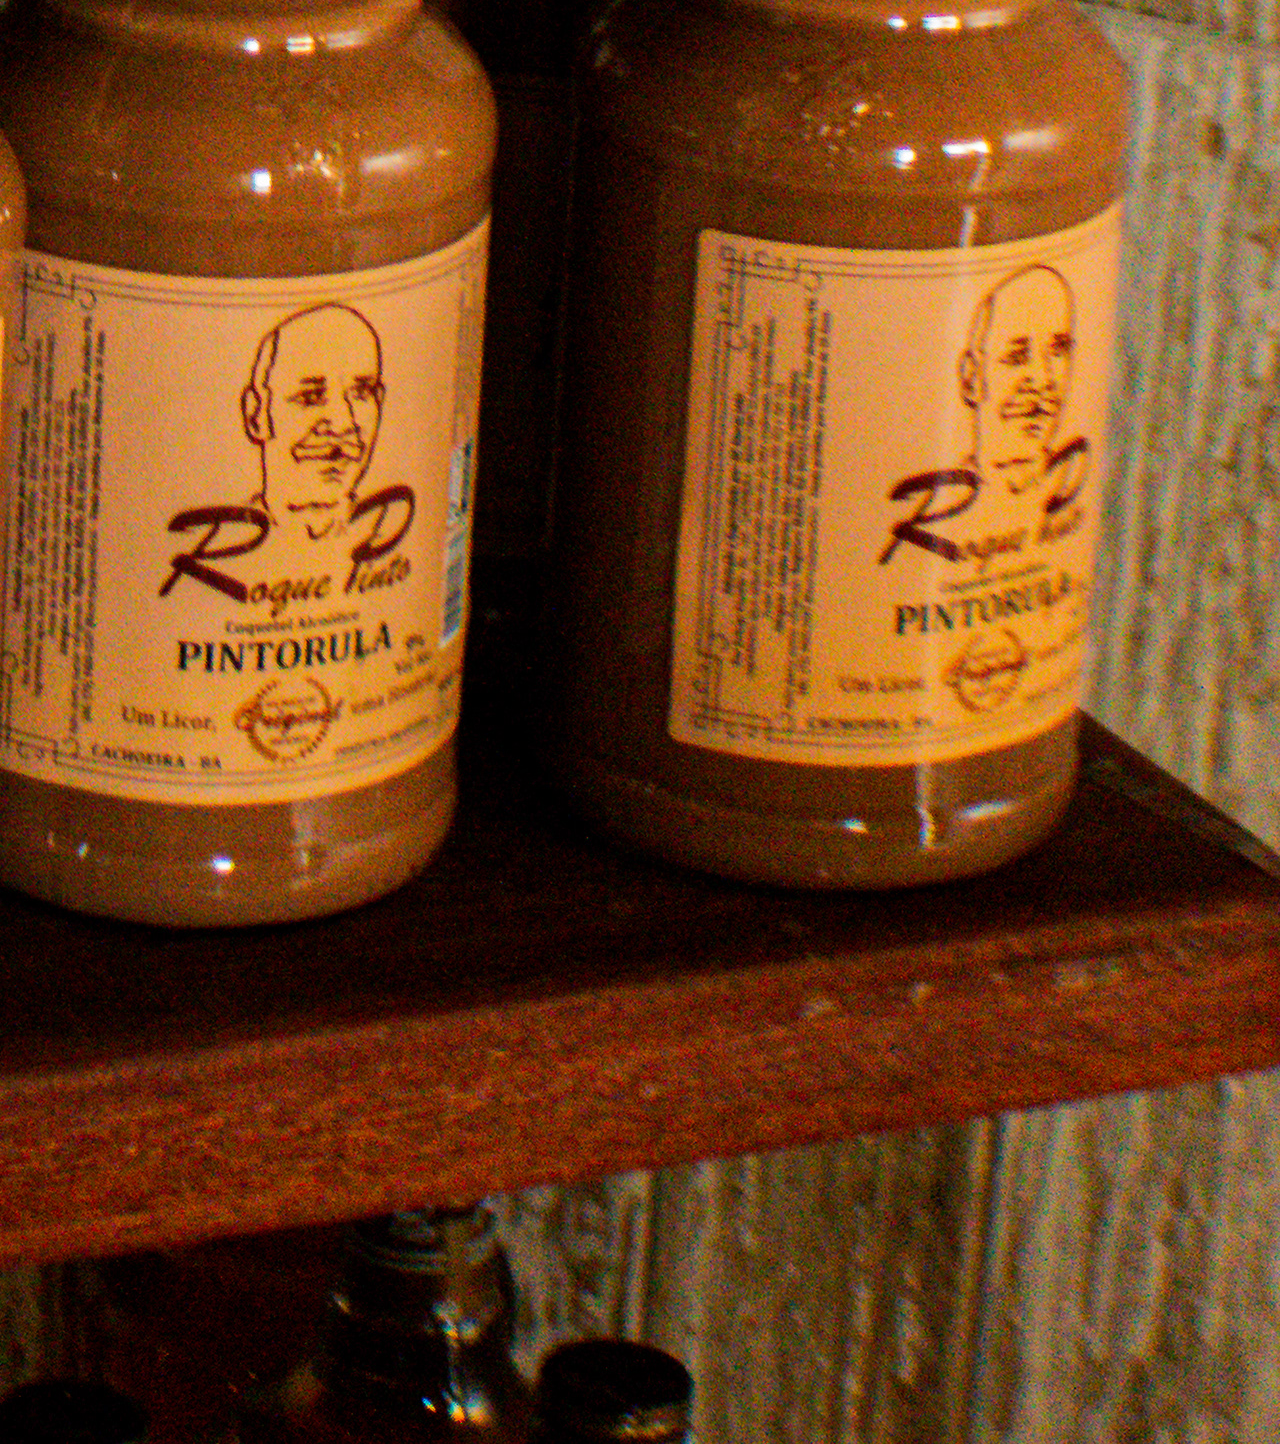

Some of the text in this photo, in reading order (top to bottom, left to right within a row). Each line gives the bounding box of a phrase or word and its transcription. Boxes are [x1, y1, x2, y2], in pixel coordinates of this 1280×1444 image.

[158, 485, 414, 618] Roque Pinto
[177, 621, 392, 673] PINTORULA
[122, 707, 155, 727] Um
[161, 710, 216, 731] Licor,
